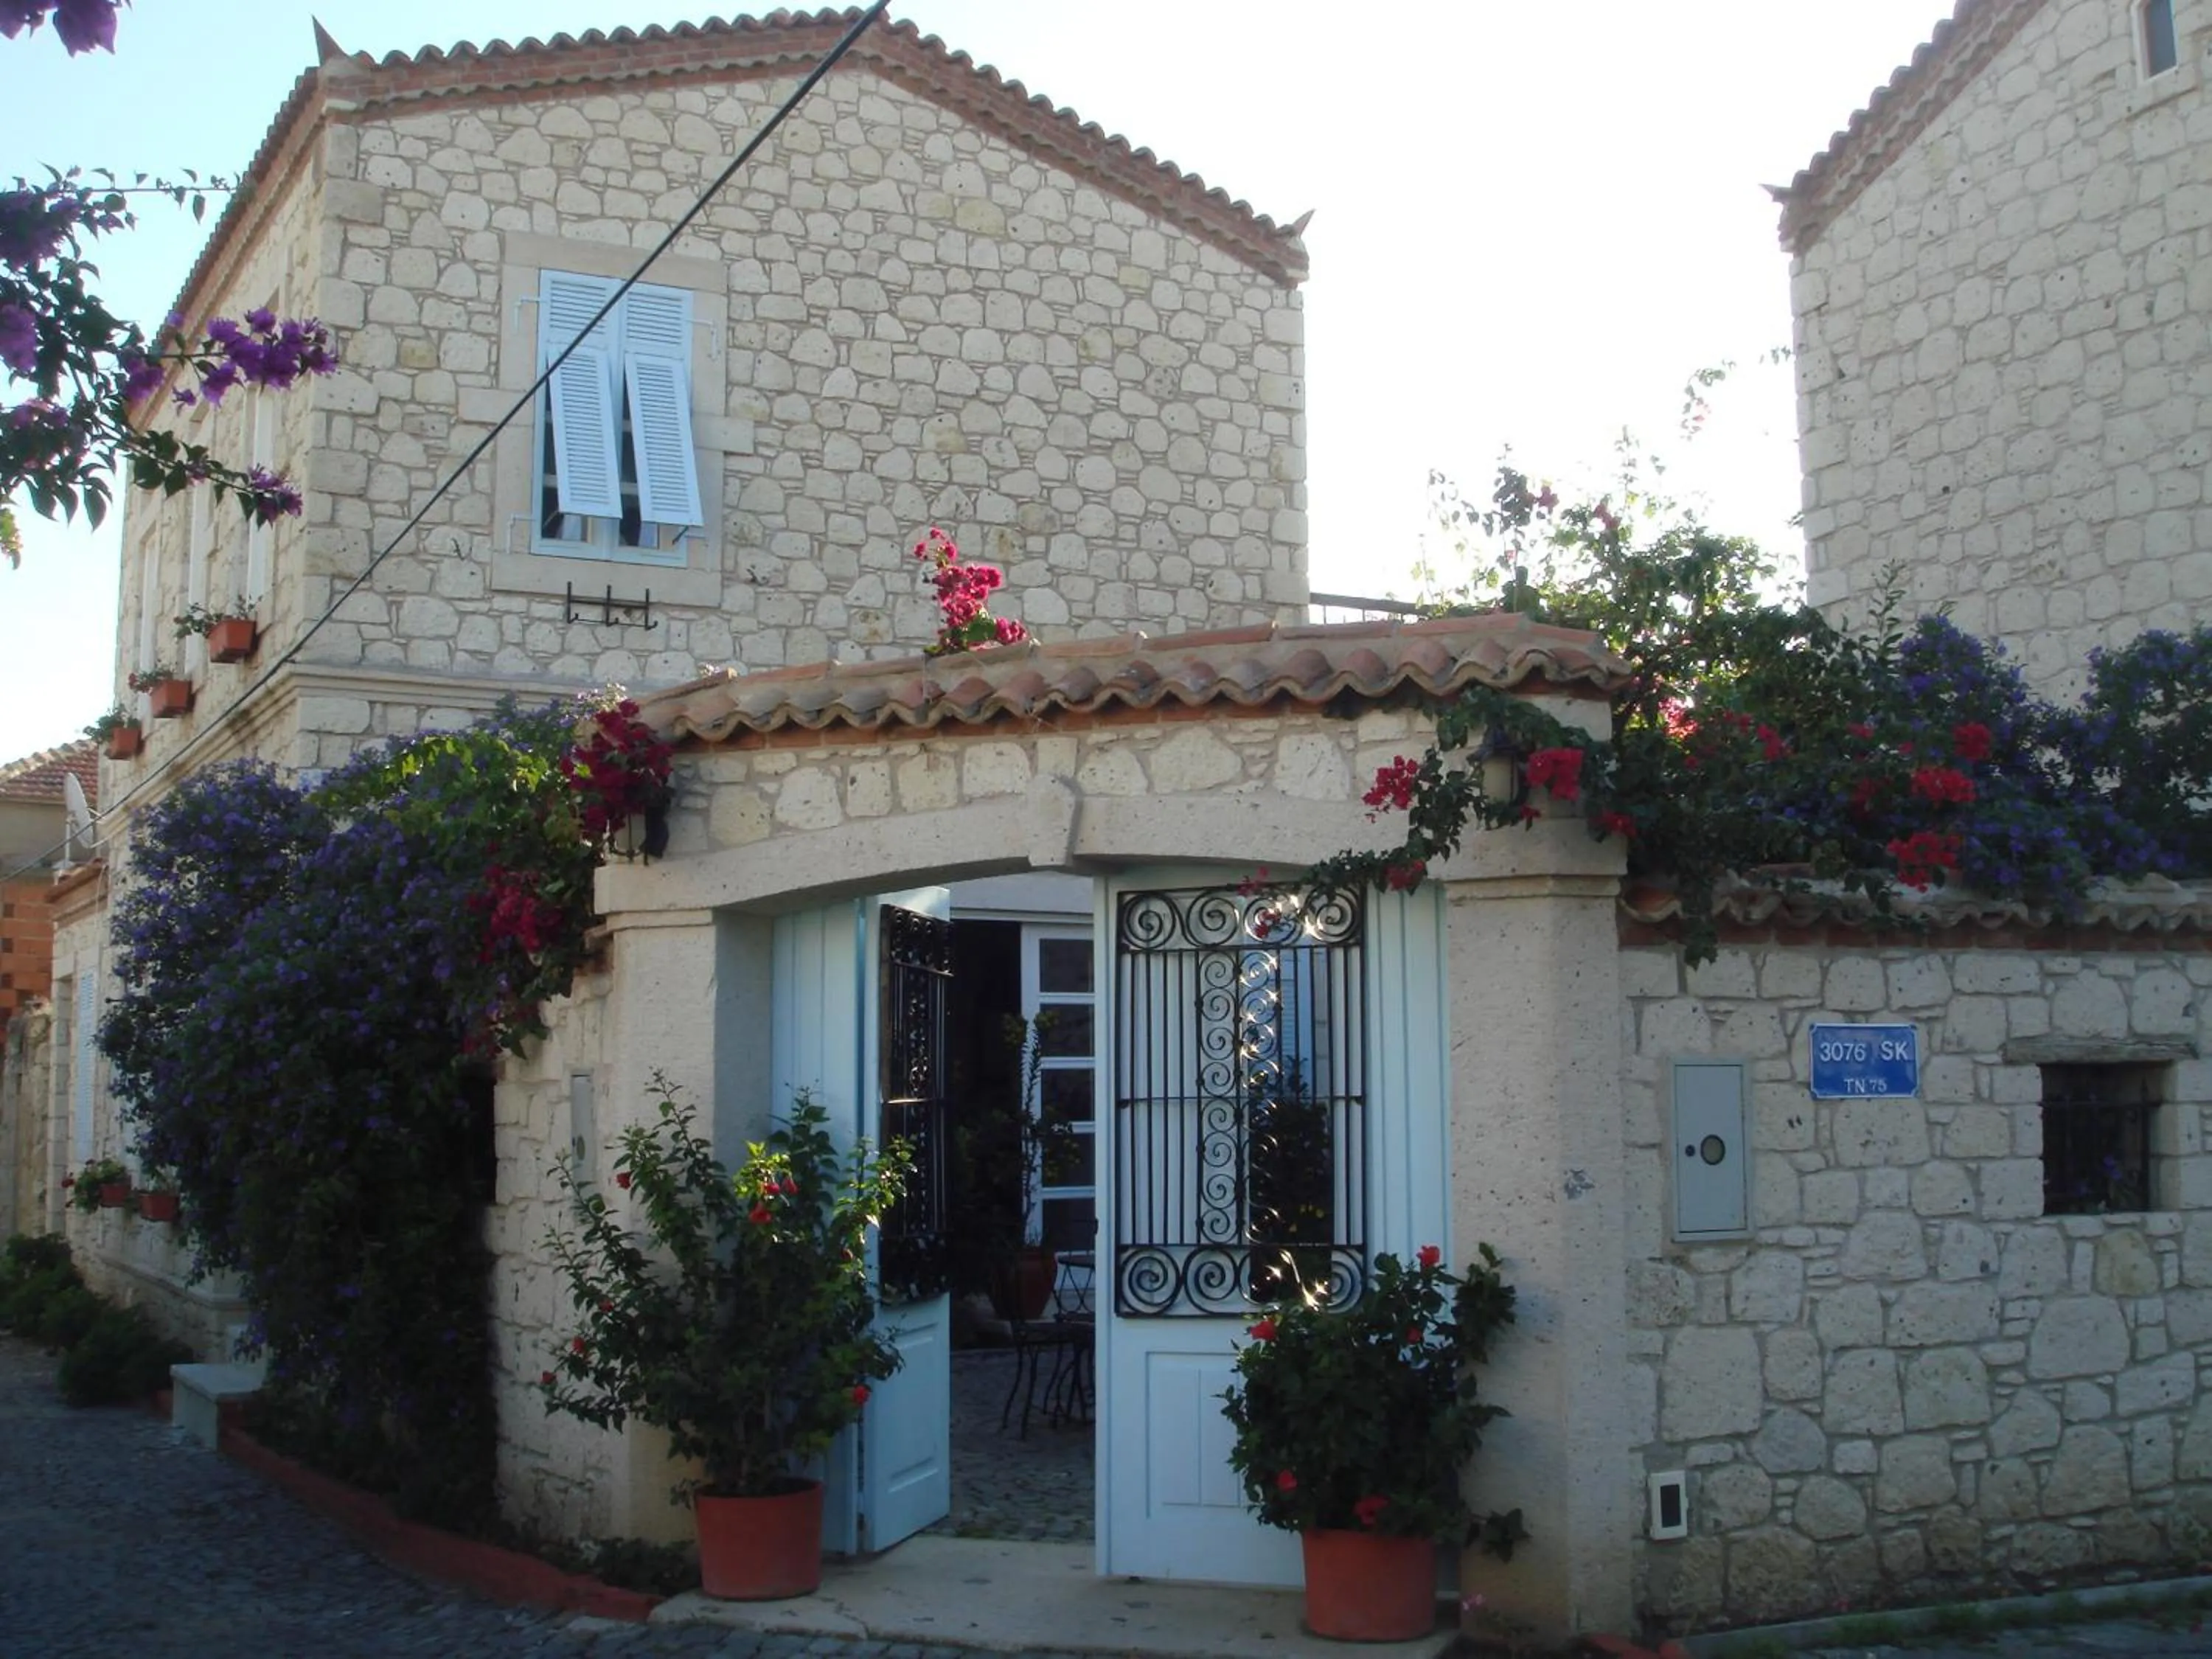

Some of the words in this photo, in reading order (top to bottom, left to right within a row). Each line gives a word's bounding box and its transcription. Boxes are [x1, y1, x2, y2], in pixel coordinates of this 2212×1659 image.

[1820, 1041, 1866, 1062] 3076
[1881, 1040, 1908, 1060] SK
[1843, 1079, 1865, 1093] TN
[1869, 1079, 1888, 1093] 75
